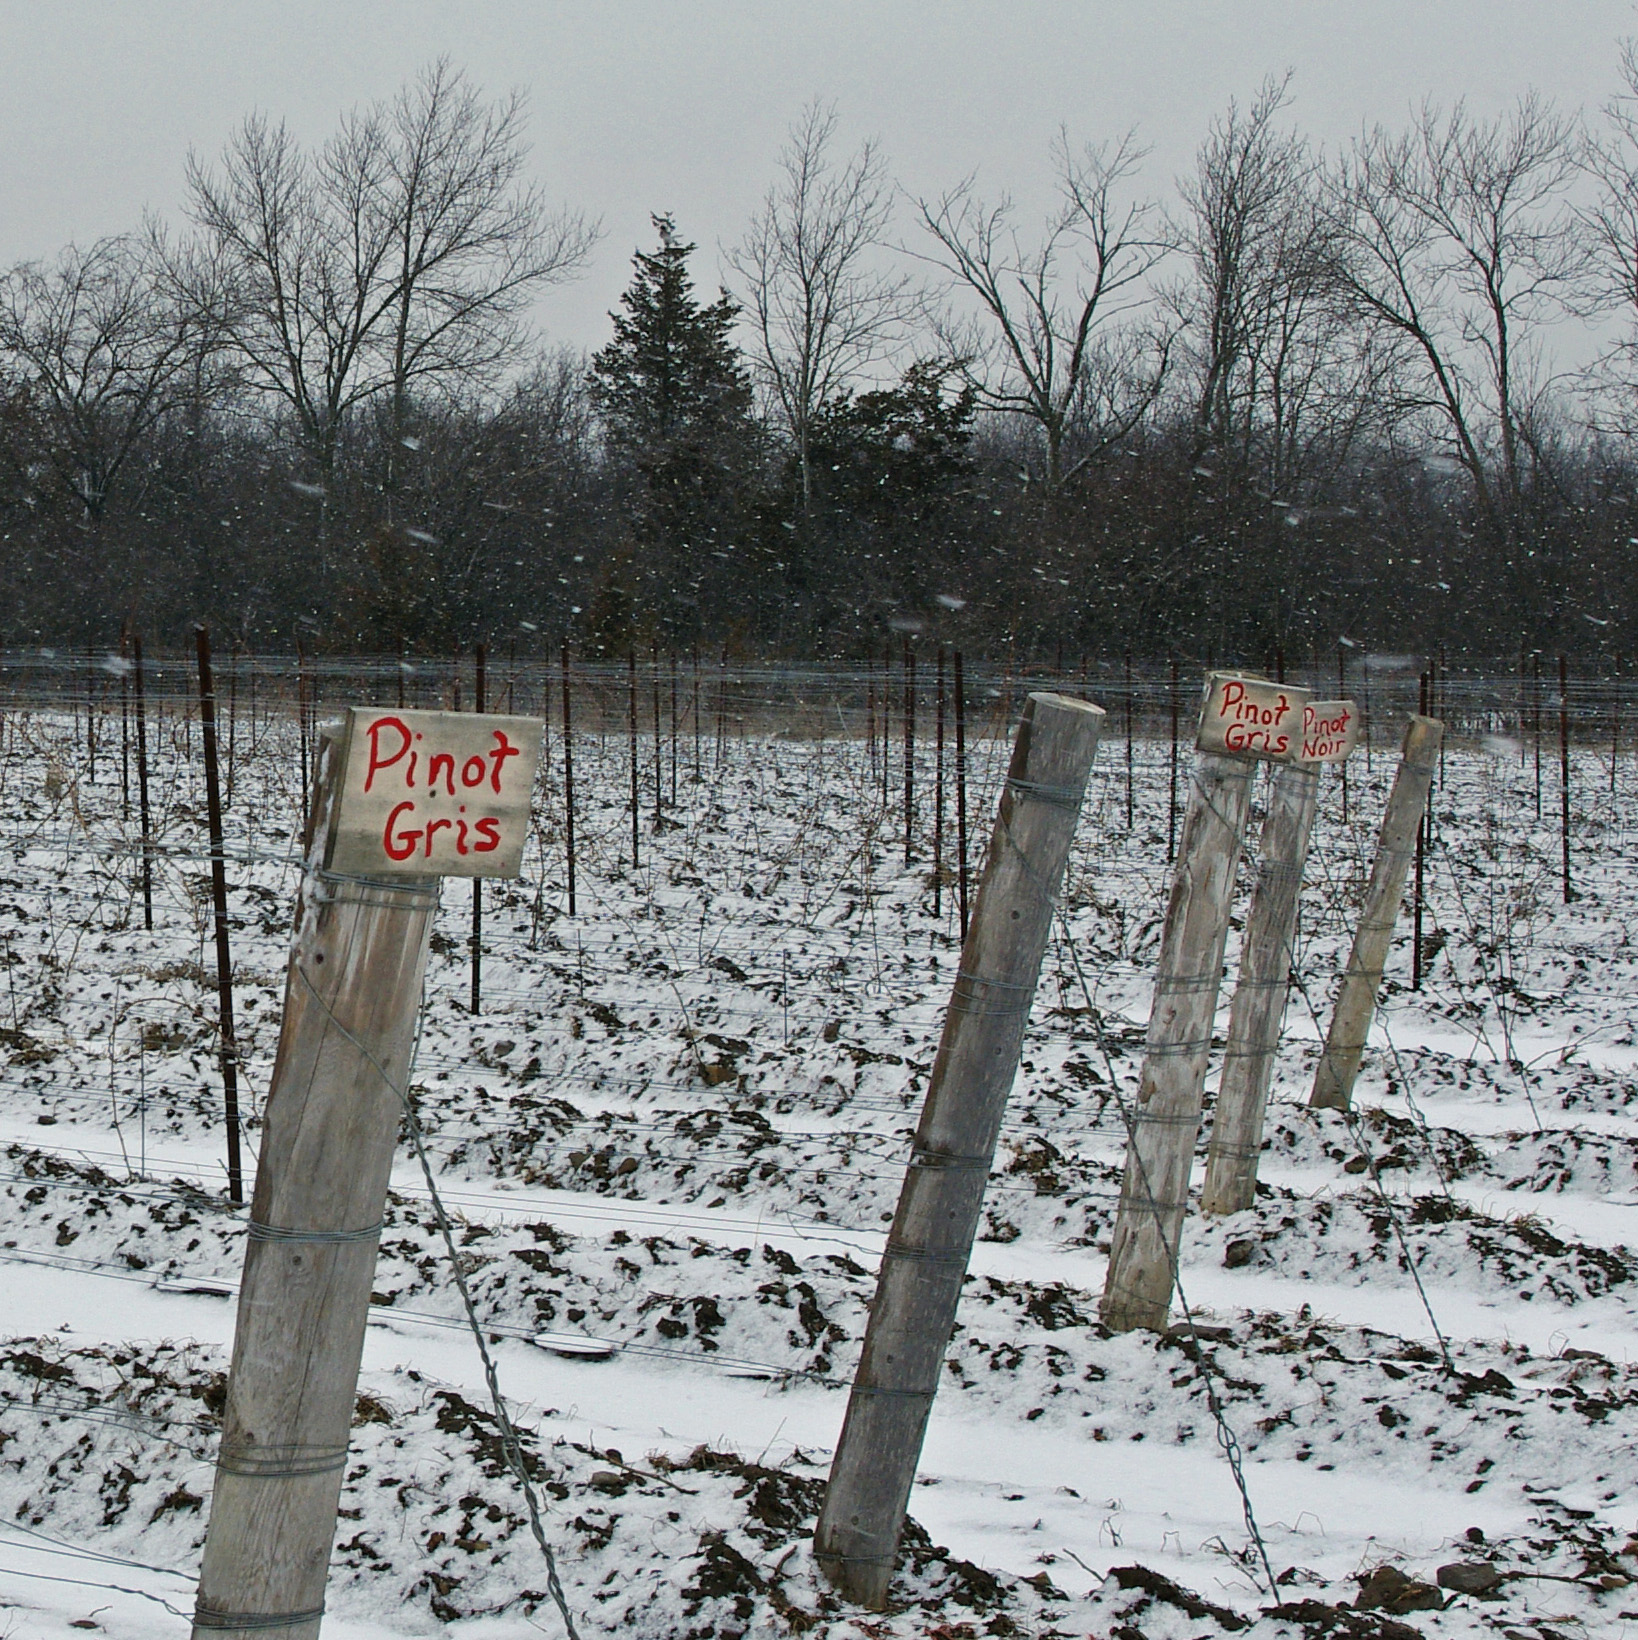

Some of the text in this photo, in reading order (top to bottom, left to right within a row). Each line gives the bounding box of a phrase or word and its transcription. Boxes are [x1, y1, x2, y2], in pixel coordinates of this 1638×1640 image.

[1220, 681, 1290, 726] Pinot
[1303, 706, 1351, 736] Pinot
[364, 716, 520, 795] Pinot
[1225, 723, 1289, 753] Gris
[1302, 736, 1346, 759] Noir
[383, 800, 502, 862] Gris
